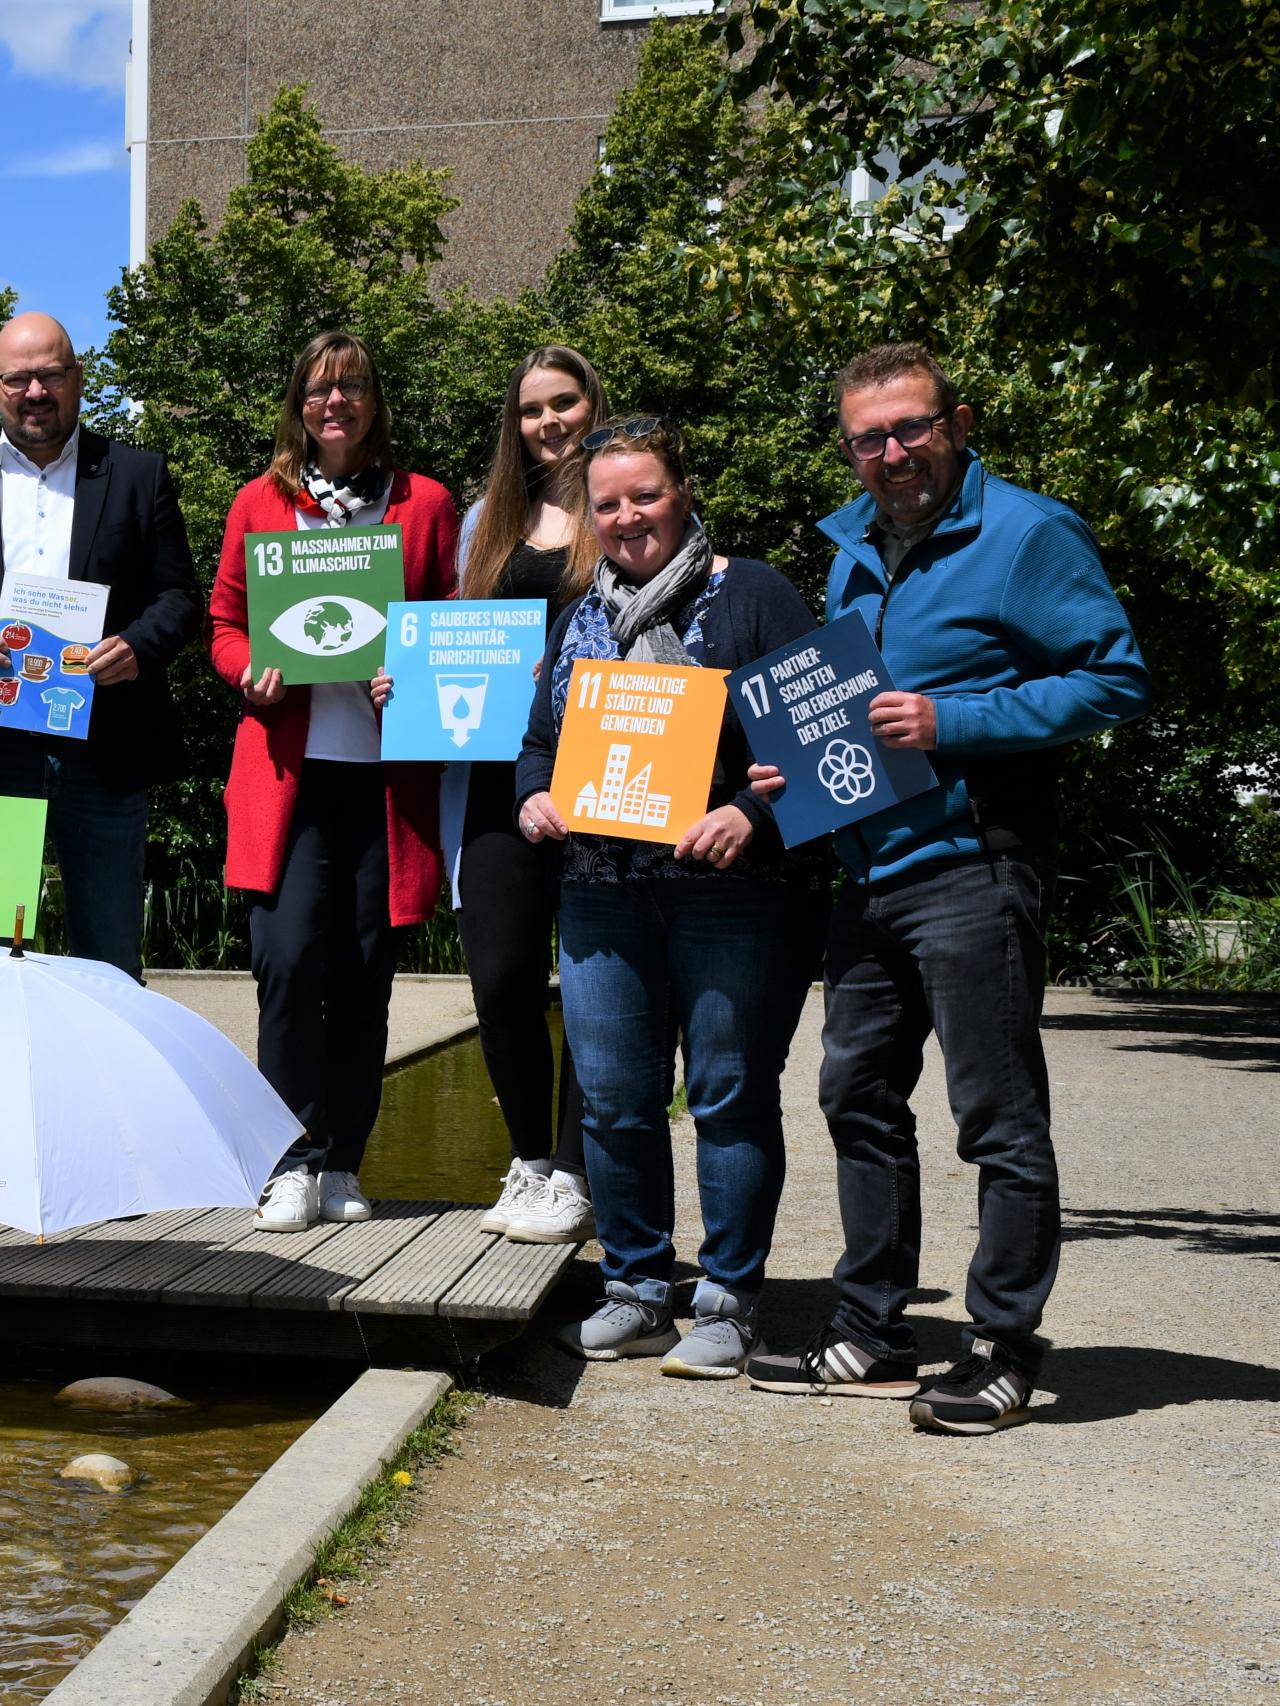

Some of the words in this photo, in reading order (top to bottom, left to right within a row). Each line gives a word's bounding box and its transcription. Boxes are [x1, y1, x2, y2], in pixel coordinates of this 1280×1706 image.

[291, 536, 371, 556] MASSNAHMEN
[372, 534, 398, 550] ZUM
[254, 542, 284, 576] 13
[291, 554, 371, 574] KLIMASCHUTZ
[28, 590, 46, 598] sehe
[42, 600, 62, 608] nicht
[64, 604, 88, 612] siehst
[400, 612, 418, 647] 6
[430, 611, 492, 628] SAUBERES
[492, 610, 542, 626] WASSER
[430, 630, 454, 646] UND
[454, 628, 510, 646] SANITÄR-
[428, 648, 520, 666] EINRICHTUNGEN
[769, 646, 822, 684] PARTNER-
[578, 672, 602, 710] 11
[608, 672, 687, 696] NACHHALTIGE
[778, 664, 837, 704] SCHAFTEN
[604, 694, 648, 714] STÄDTE
[648, 698, 674, 716] UND
[740, 673, 771, 719] 17
[788, 701, 812, 726] ZUR
[808, 670, 879, 717] ERREICHUNG
[600, 715, 666, 736] GEMEINDEN
[796, 722, 822, 747] DER
[818, 708, 851, 738] ZIELE
